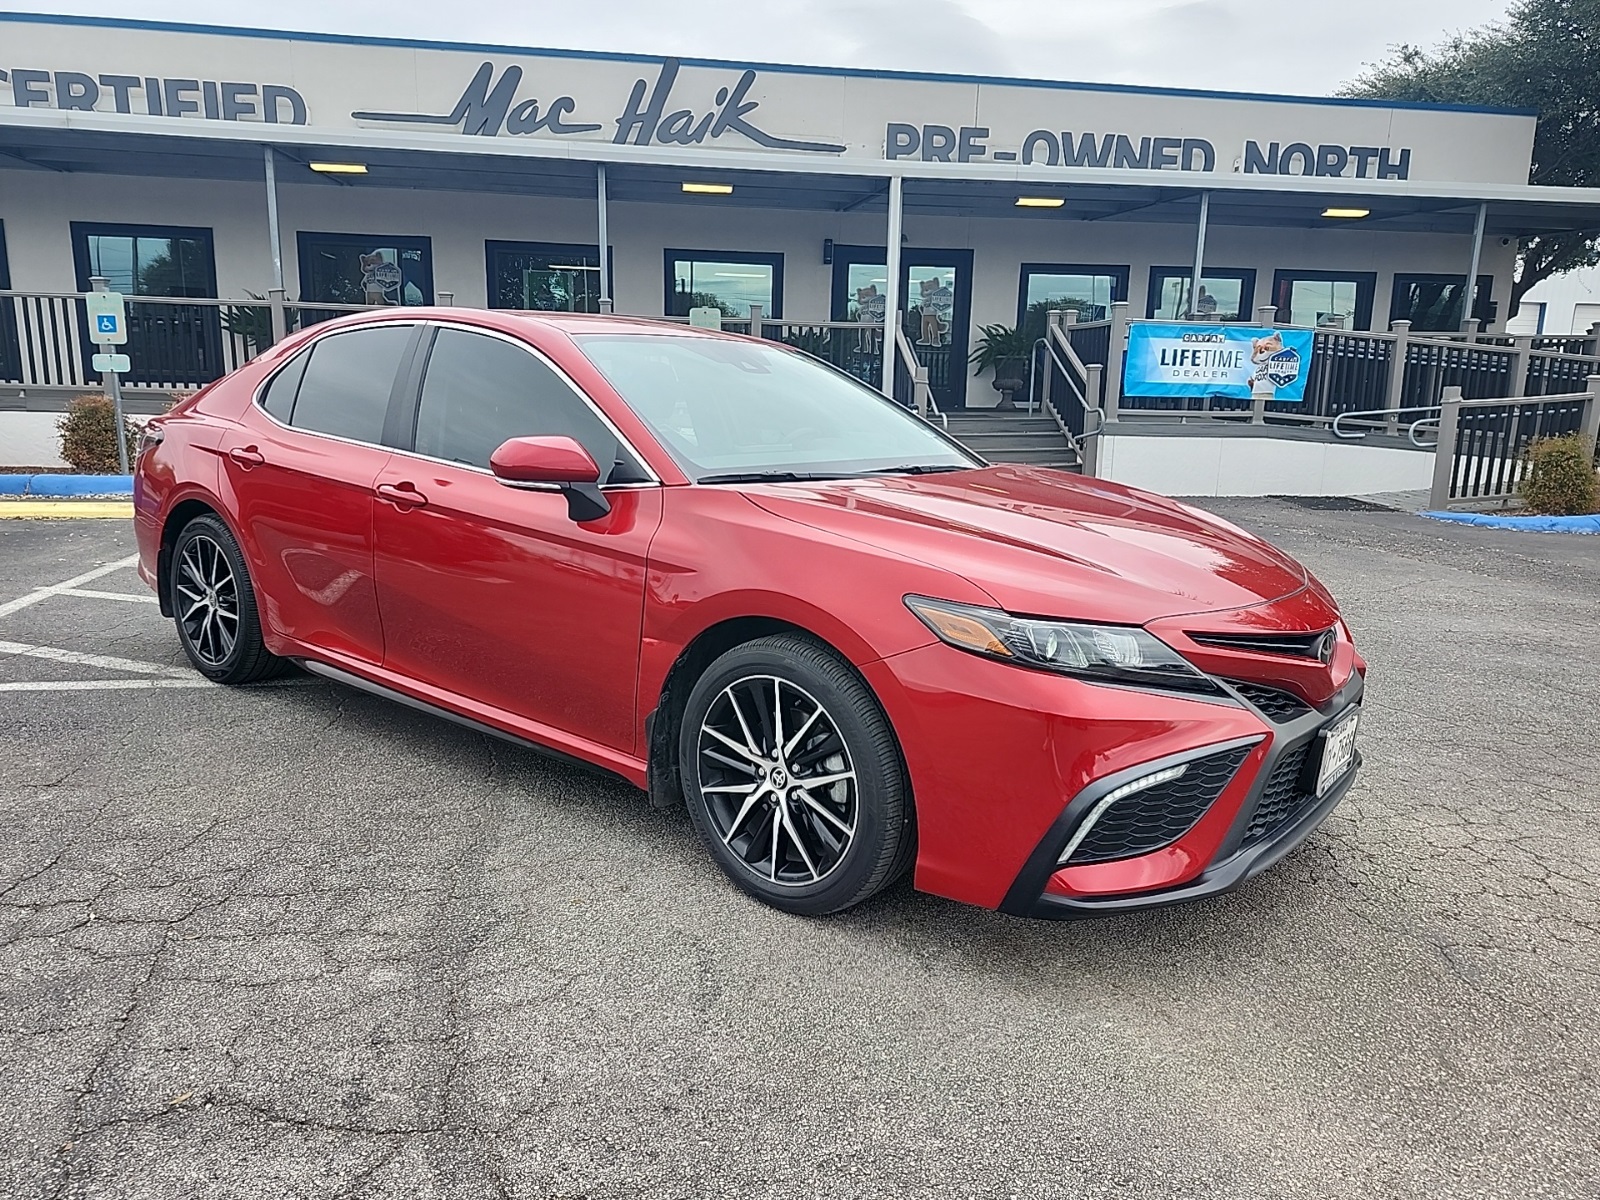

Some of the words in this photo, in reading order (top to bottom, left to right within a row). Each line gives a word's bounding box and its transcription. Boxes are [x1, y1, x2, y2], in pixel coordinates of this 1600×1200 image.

[0, 68, 307, 126] ERTIFIED
[351, 61, 602, 137] Mac
[612, 57, 846, 152] Haik
[885, 122, 1215, 173] PRE-OWNED
[1243, 140, 1411, 181] NORTH
[1182, 334, 1226, 343] CARFAX
[1160, 349, 1244, 368] LIFETIME
[1172, 369, 1229, 378] DEALER
